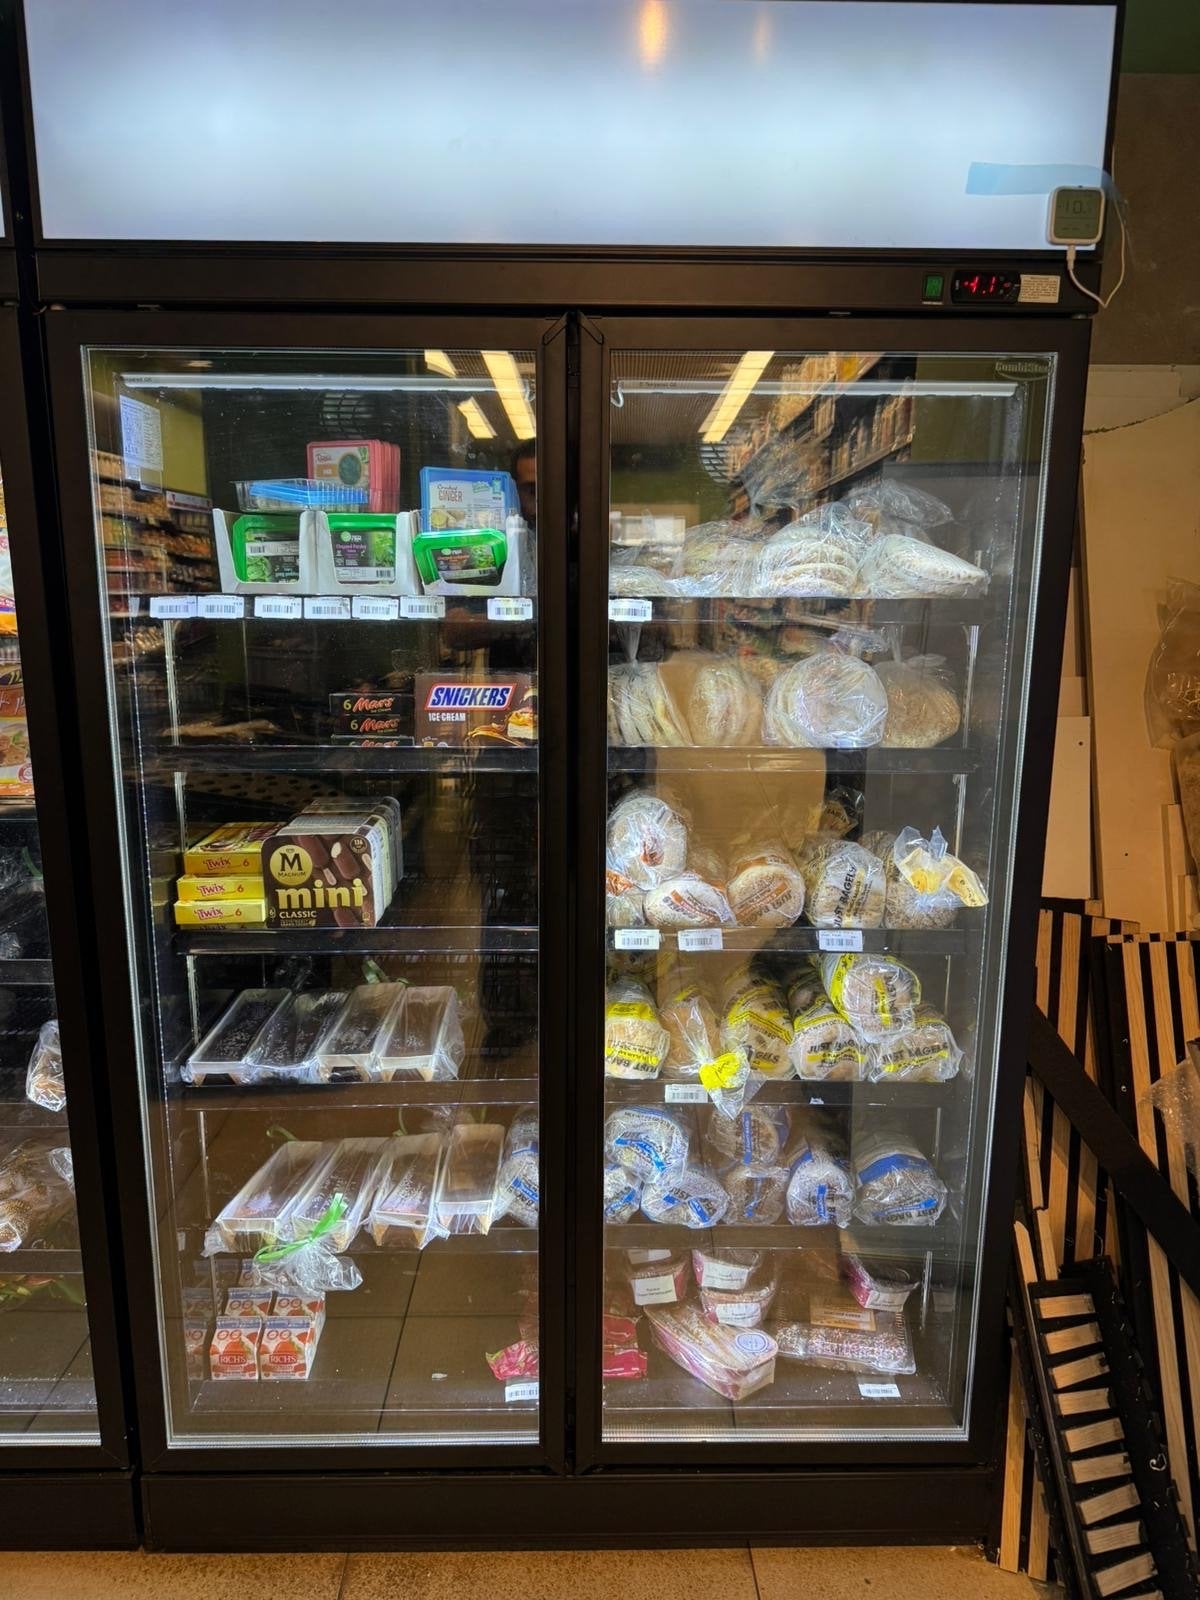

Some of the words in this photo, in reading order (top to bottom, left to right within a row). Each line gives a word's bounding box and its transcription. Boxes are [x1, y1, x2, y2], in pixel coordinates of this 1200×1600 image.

[431, 687, 511, 706] SNICKERS
[343, 699, 351, 710] 6
[352, 696, 395, 712] Mars
[428, 712, 441, 722] ICE
[442, 712, 466, 722] CREAM
[350, 719, 358, 730] 6
[359, 718, 399, 732] Mars
[203, 857, 231, 870] Twix
[242, 859, 250, 867] 6
[279, 853, 303, 871] M
[197, 883, 225, 896] Twix
[236, 884, 244, 893] 6
[275, 878, 364, 909] mini
[194, 907, 223, 920] Twix
[235, 908, 242, 917] 6
[279, 910, 318, 918] CLASSIC
[832, 906, 844, 928] JUST
[670, 1187, 691, 1200] JUST
